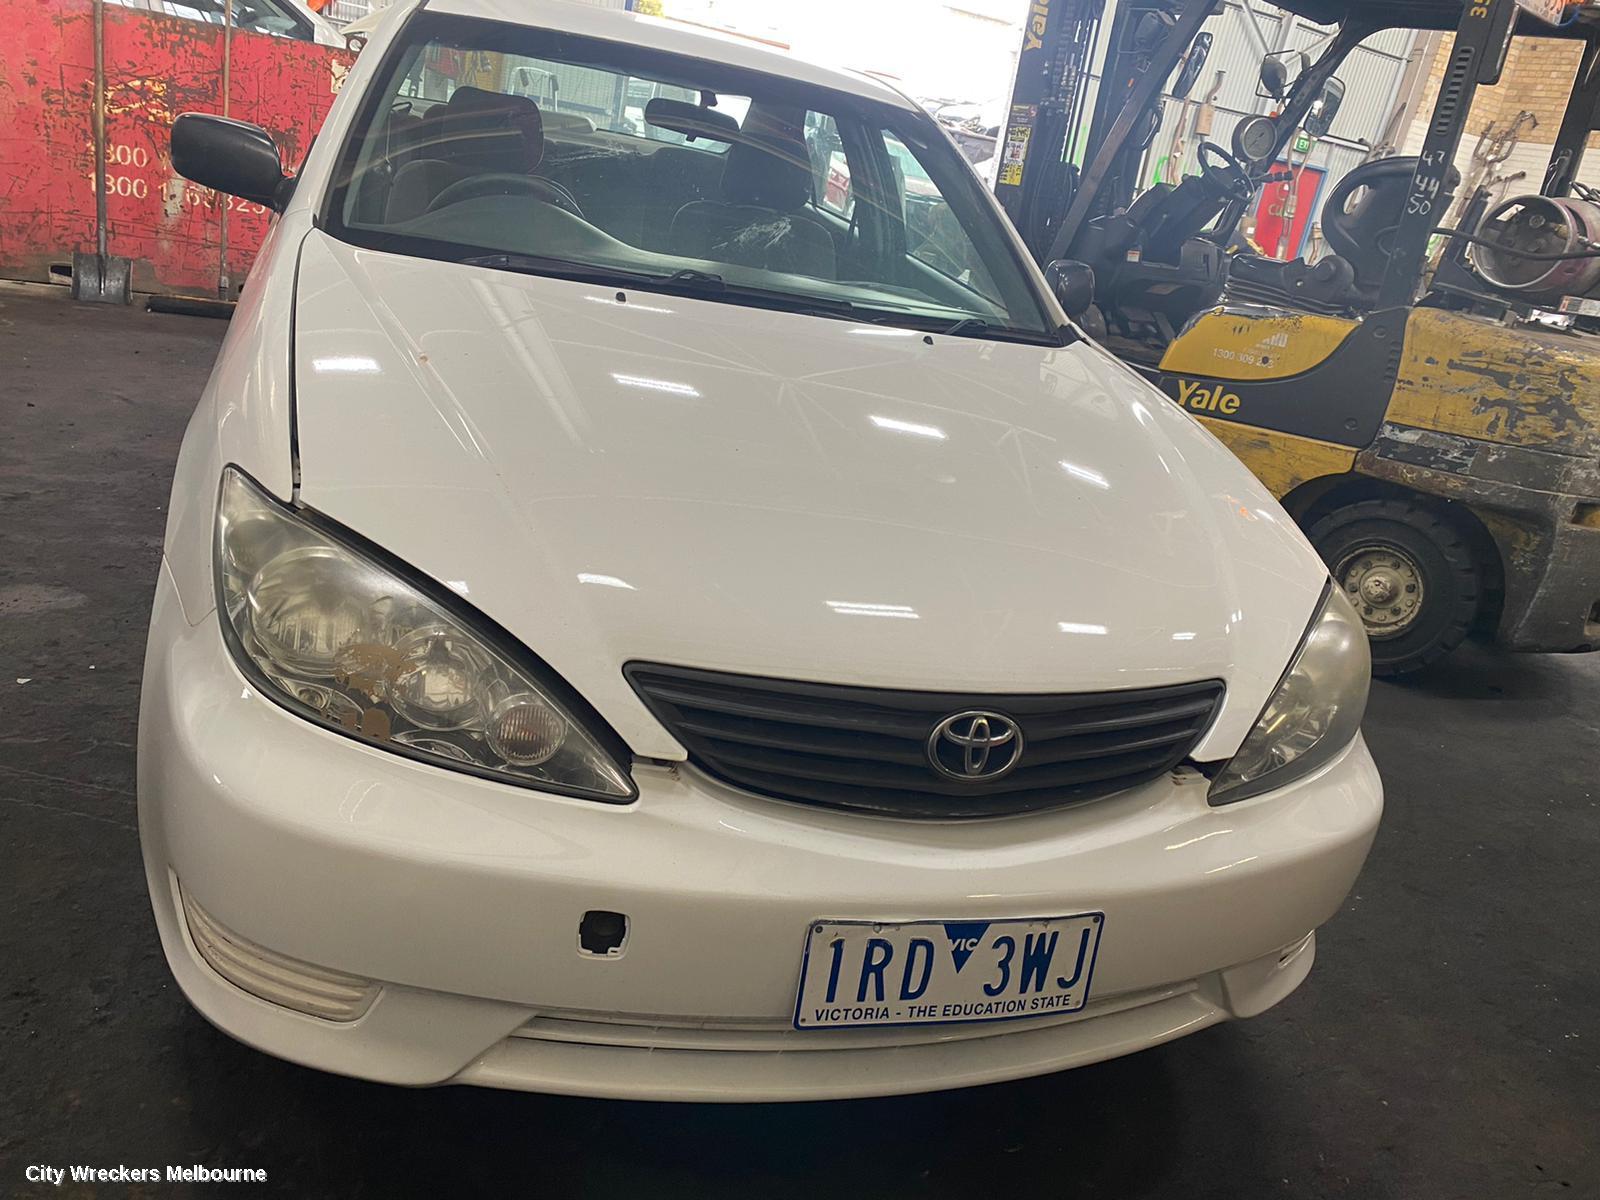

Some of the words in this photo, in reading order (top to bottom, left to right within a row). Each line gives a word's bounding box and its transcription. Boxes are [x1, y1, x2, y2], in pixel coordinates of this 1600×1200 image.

[1422, 150, 1446, 167] 47
[88, 172, 148, 199] 1300
[1407, 193, 1431, 215] 50
[1213, 347, 1235, 360] 1300
[1255, 356, 1275, 369] 23
[1178, 379, 1241, 415] Yale
[825, 937, 935, 1004] 1RD
[949, 937, 979, 952] VIC
[982, 927, 1091, 997] 3WJ
[814, 1006, 890, 1022] VICTORIA
[907, 1004, 938, 1018] THE
[942, 999, 1027, 1017] EDUCATION
[1030, 993, 1071, 1010] STATE
